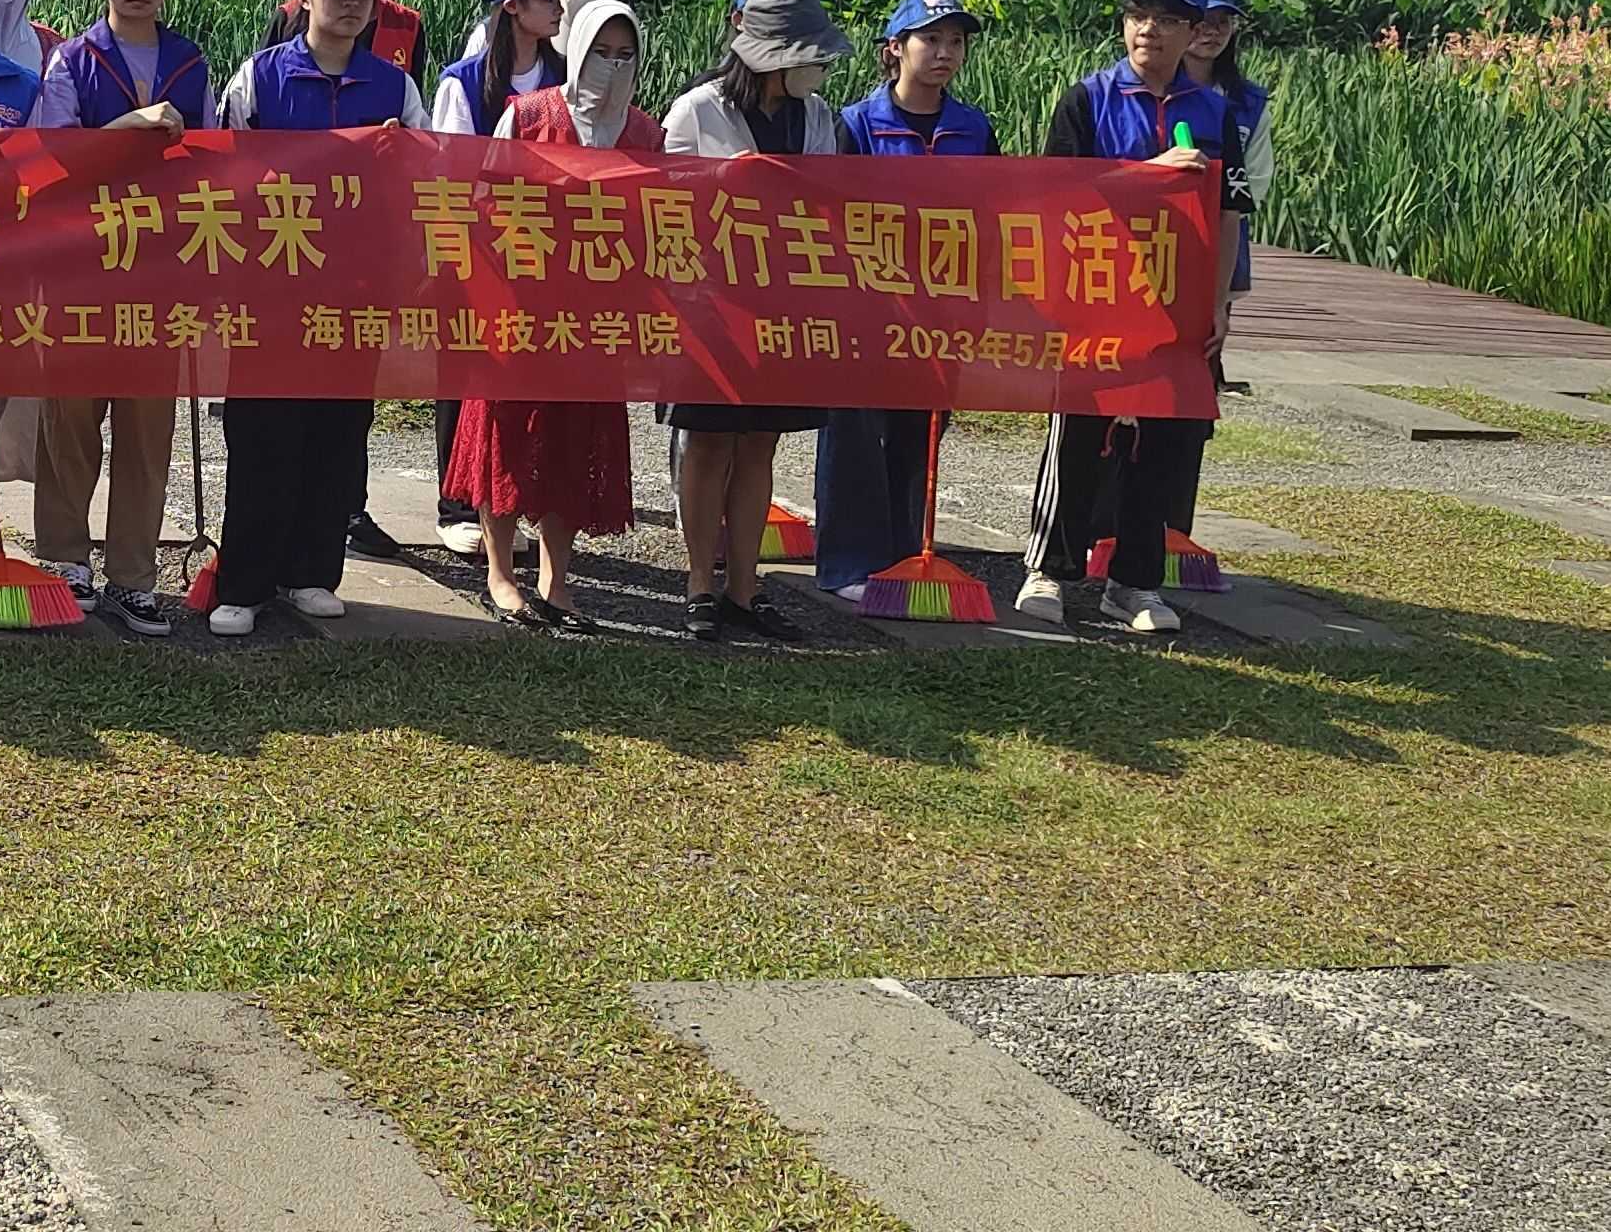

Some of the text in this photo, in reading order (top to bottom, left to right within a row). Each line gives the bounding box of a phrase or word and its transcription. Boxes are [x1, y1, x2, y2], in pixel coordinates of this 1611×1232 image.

[301, 304, 682, 355] 海南职业技术学院
